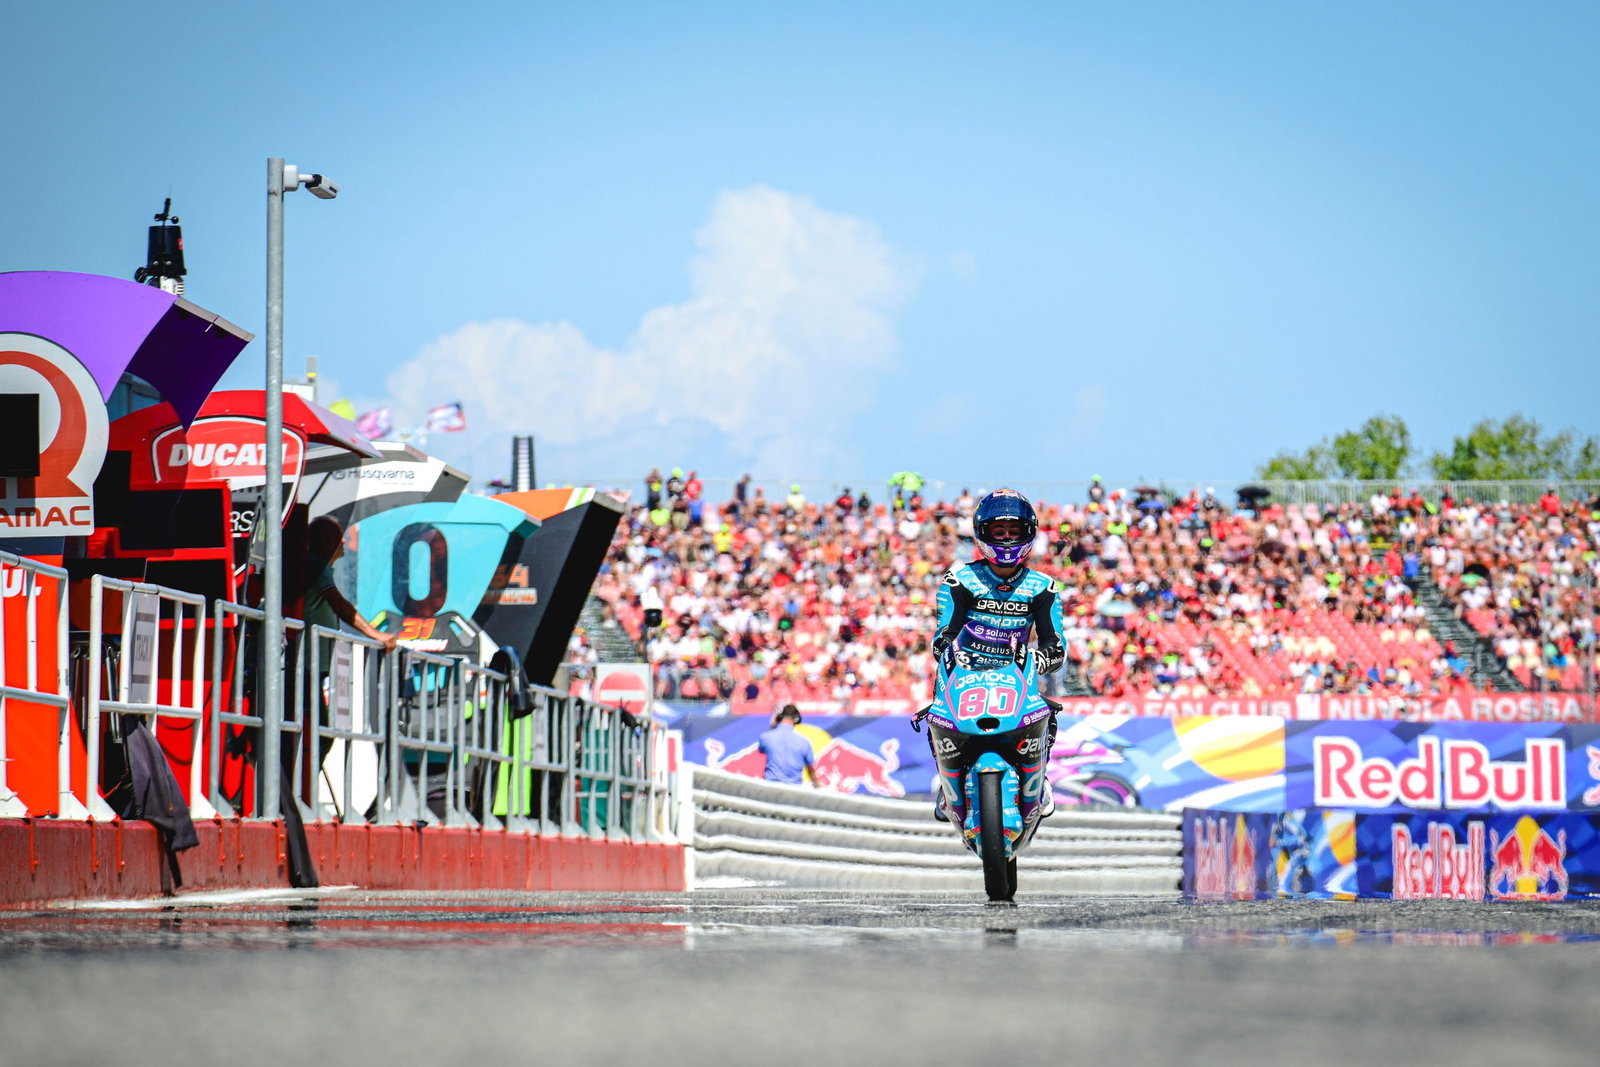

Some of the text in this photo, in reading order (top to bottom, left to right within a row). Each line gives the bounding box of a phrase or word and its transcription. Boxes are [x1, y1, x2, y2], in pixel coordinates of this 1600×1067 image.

[348, 468, 415, 481] Husqvarna
[976, 599, 1029, 613] gaviota
[954, 672, 1017, 690] gaviota
[957, 686, 1018, 720] 80
[1144, 701, 1205, 717] FAN
[1211, 701, 1292, 718] CLUB
[1328, 697, 1585, 721] NUVOLA ROSSA
[1317, 739, 1564, 806] Red Bull
[1393, 822, 1484, 899] Red Bull
